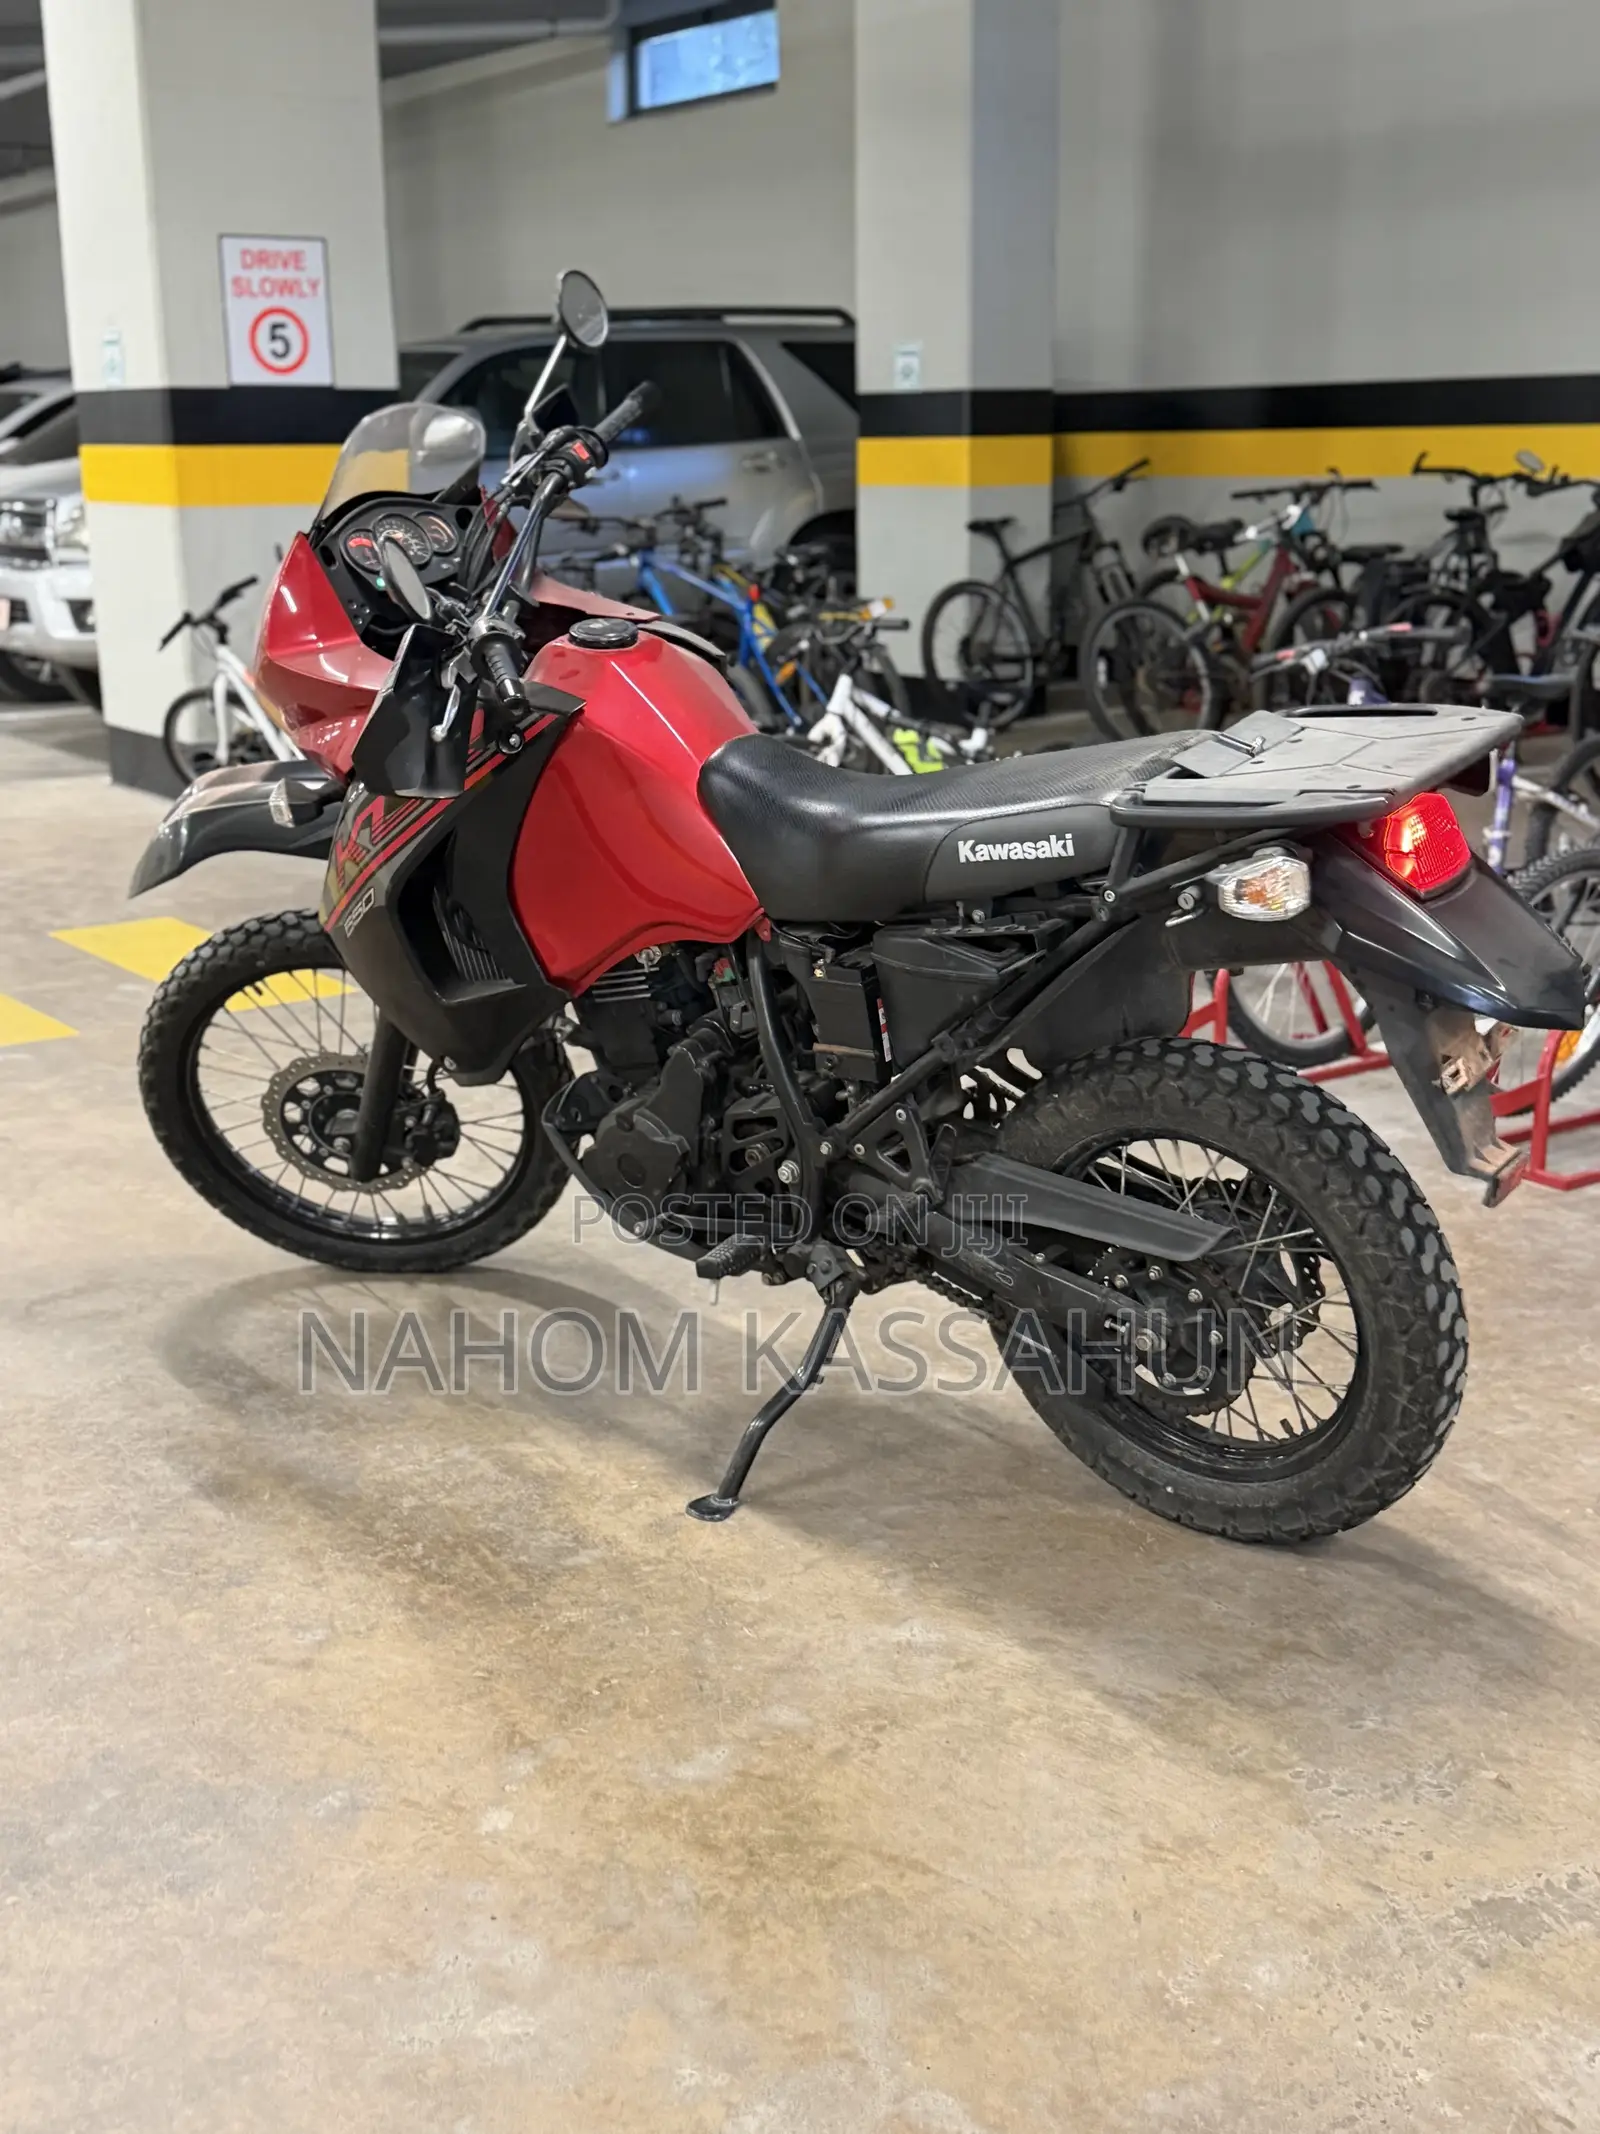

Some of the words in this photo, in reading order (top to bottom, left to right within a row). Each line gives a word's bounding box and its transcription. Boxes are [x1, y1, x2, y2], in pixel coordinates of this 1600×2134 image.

[240, 248, 307, 271] DRIVE
[231, 276, 321, 298] SLOWLY
[269, 321, 291, 360] 5
[957, 833, 1075, 863] Kawasaki
